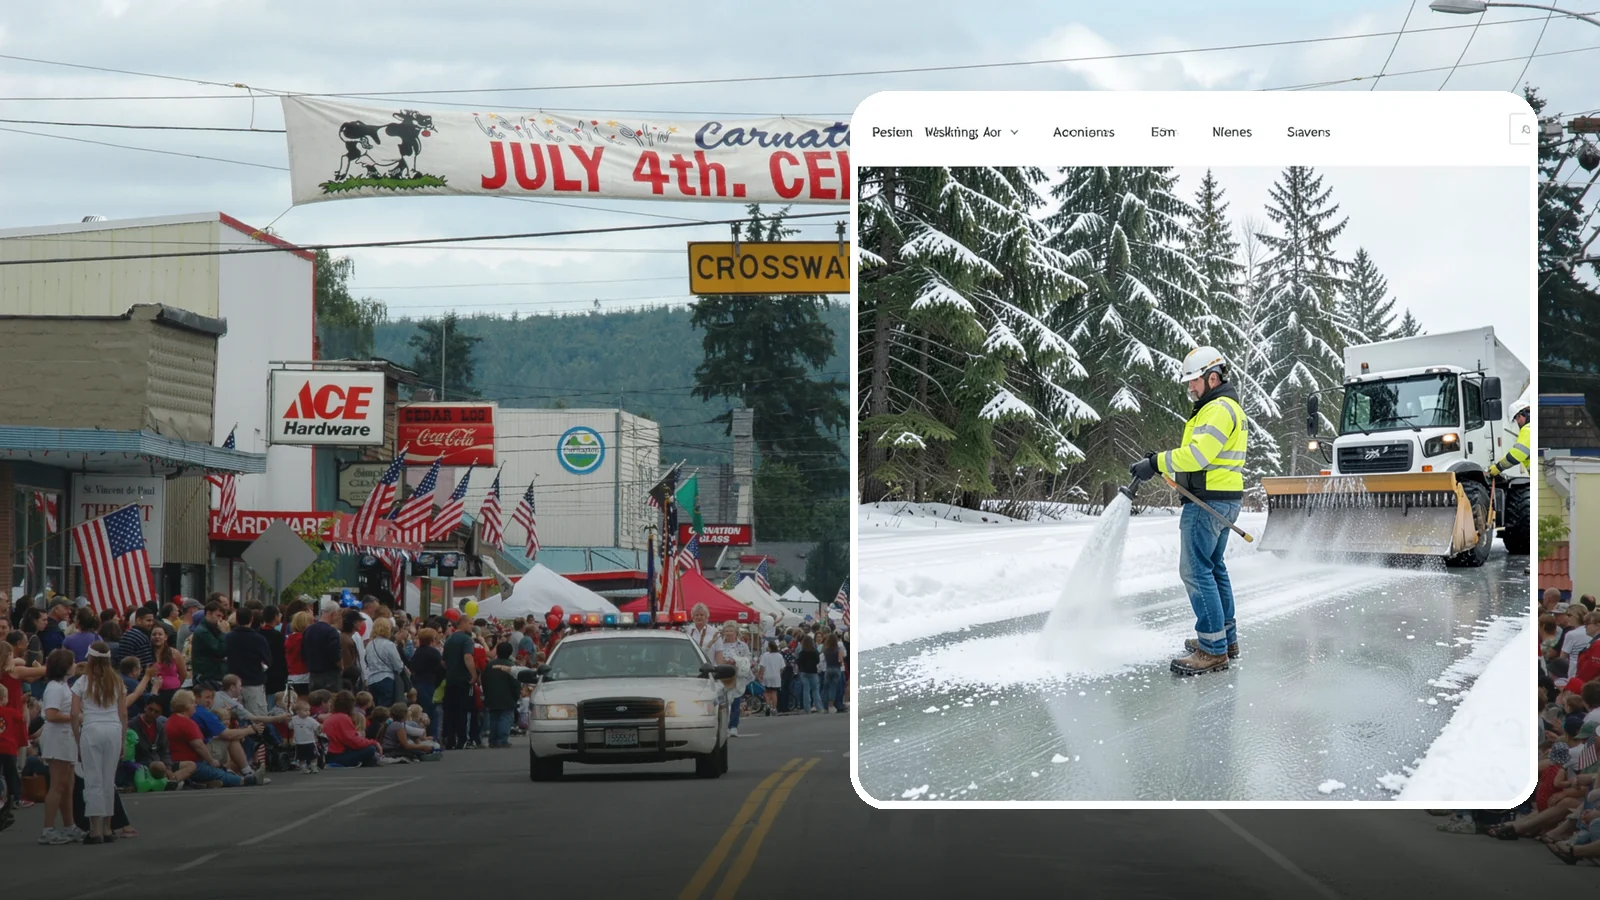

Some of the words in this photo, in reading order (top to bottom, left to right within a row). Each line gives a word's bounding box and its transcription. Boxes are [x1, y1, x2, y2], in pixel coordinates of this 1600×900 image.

[695, 121, 850, 150] Carnat
[481, 141, 605, 193] JULY
[632, 149, 746, 198] 4th.
[697, 254, 850, 280] CROSSWA
[283, 380, 373, 420] ACE
[405, 409, 453, 422] CEDAR
[461, 409, 485, 421] LOG
[283, 421, 371, 437] Hardware
[416, 428, 477, 447] Coca-Cola
[95, 485, 124, 495] Vincent
[126, 486, 136, 495] de
[137, 486, 155, 495] Paul
[688, 526, 741, 535] CRNATION
[699, 535, 730, 543] GLASS
